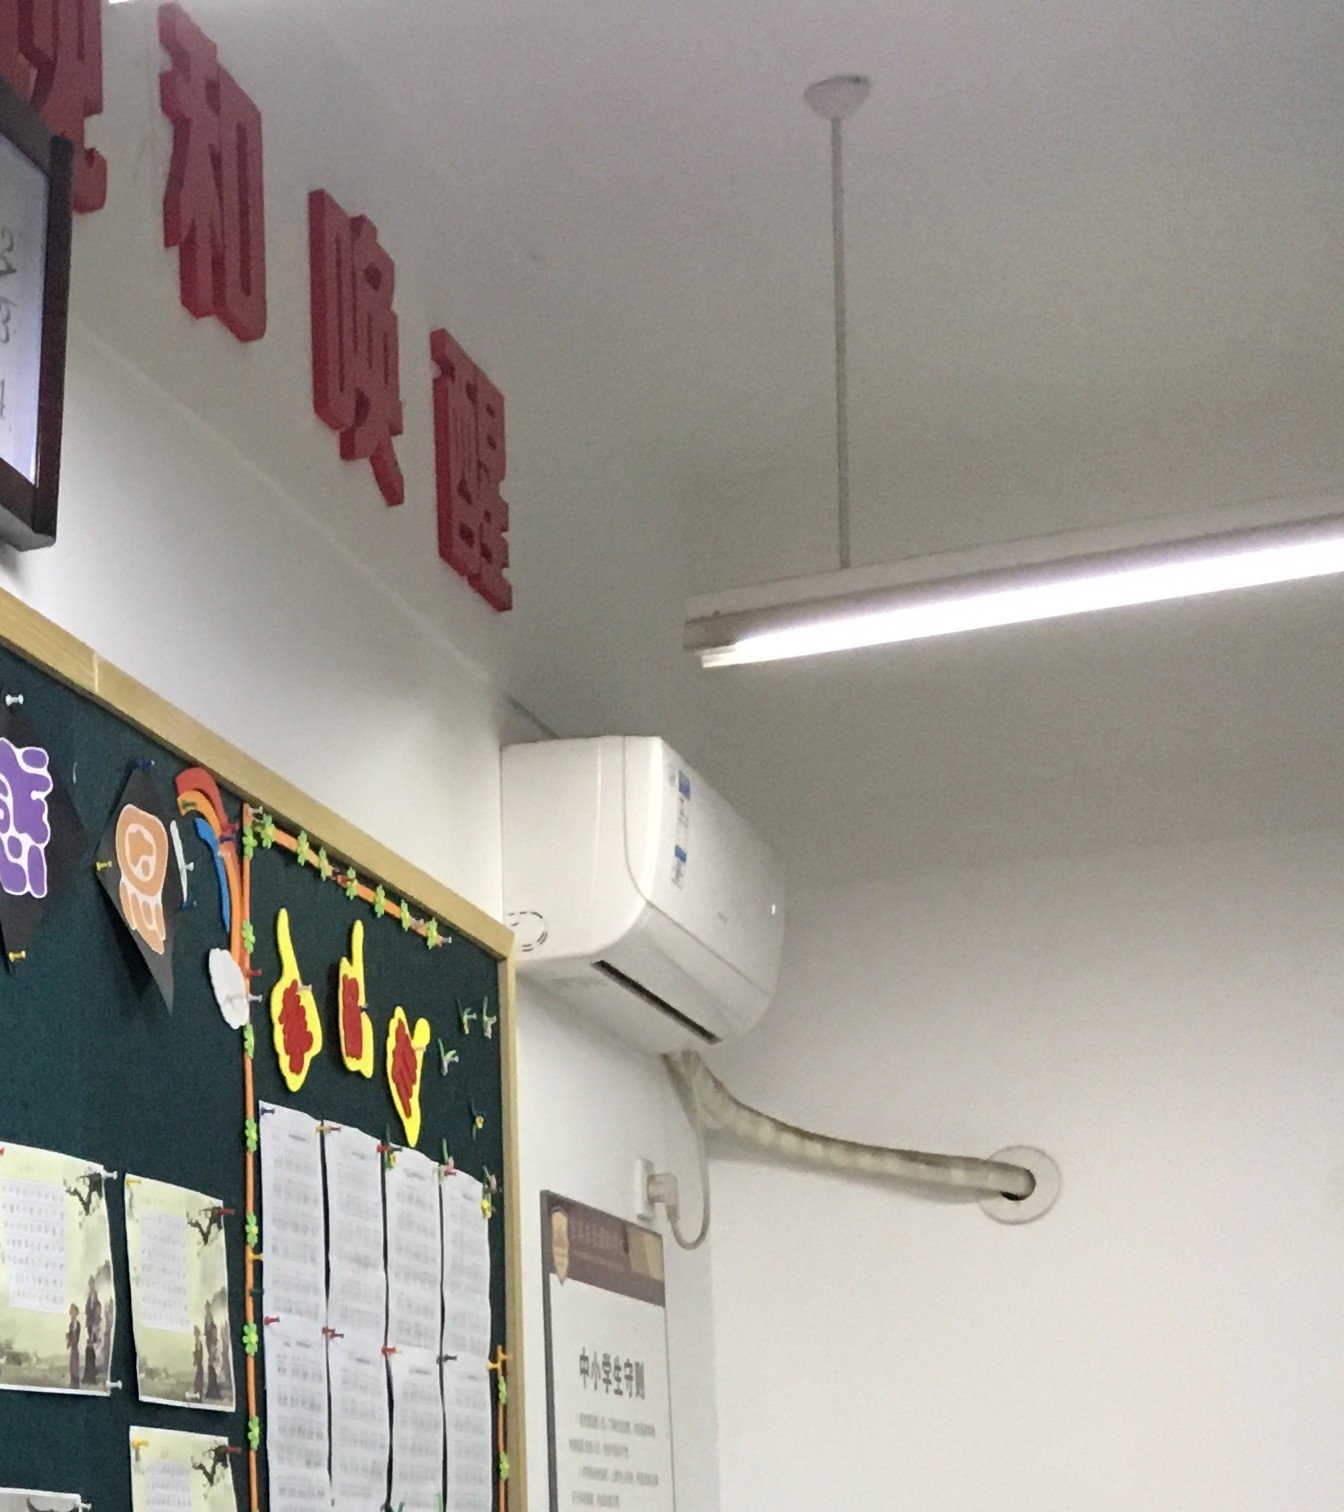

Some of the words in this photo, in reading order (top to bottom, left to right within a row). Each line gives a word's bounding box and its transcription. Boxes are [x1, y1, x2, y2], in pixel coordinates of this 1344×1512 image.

[578, 1345, 647, 1401] 中小学生守则
